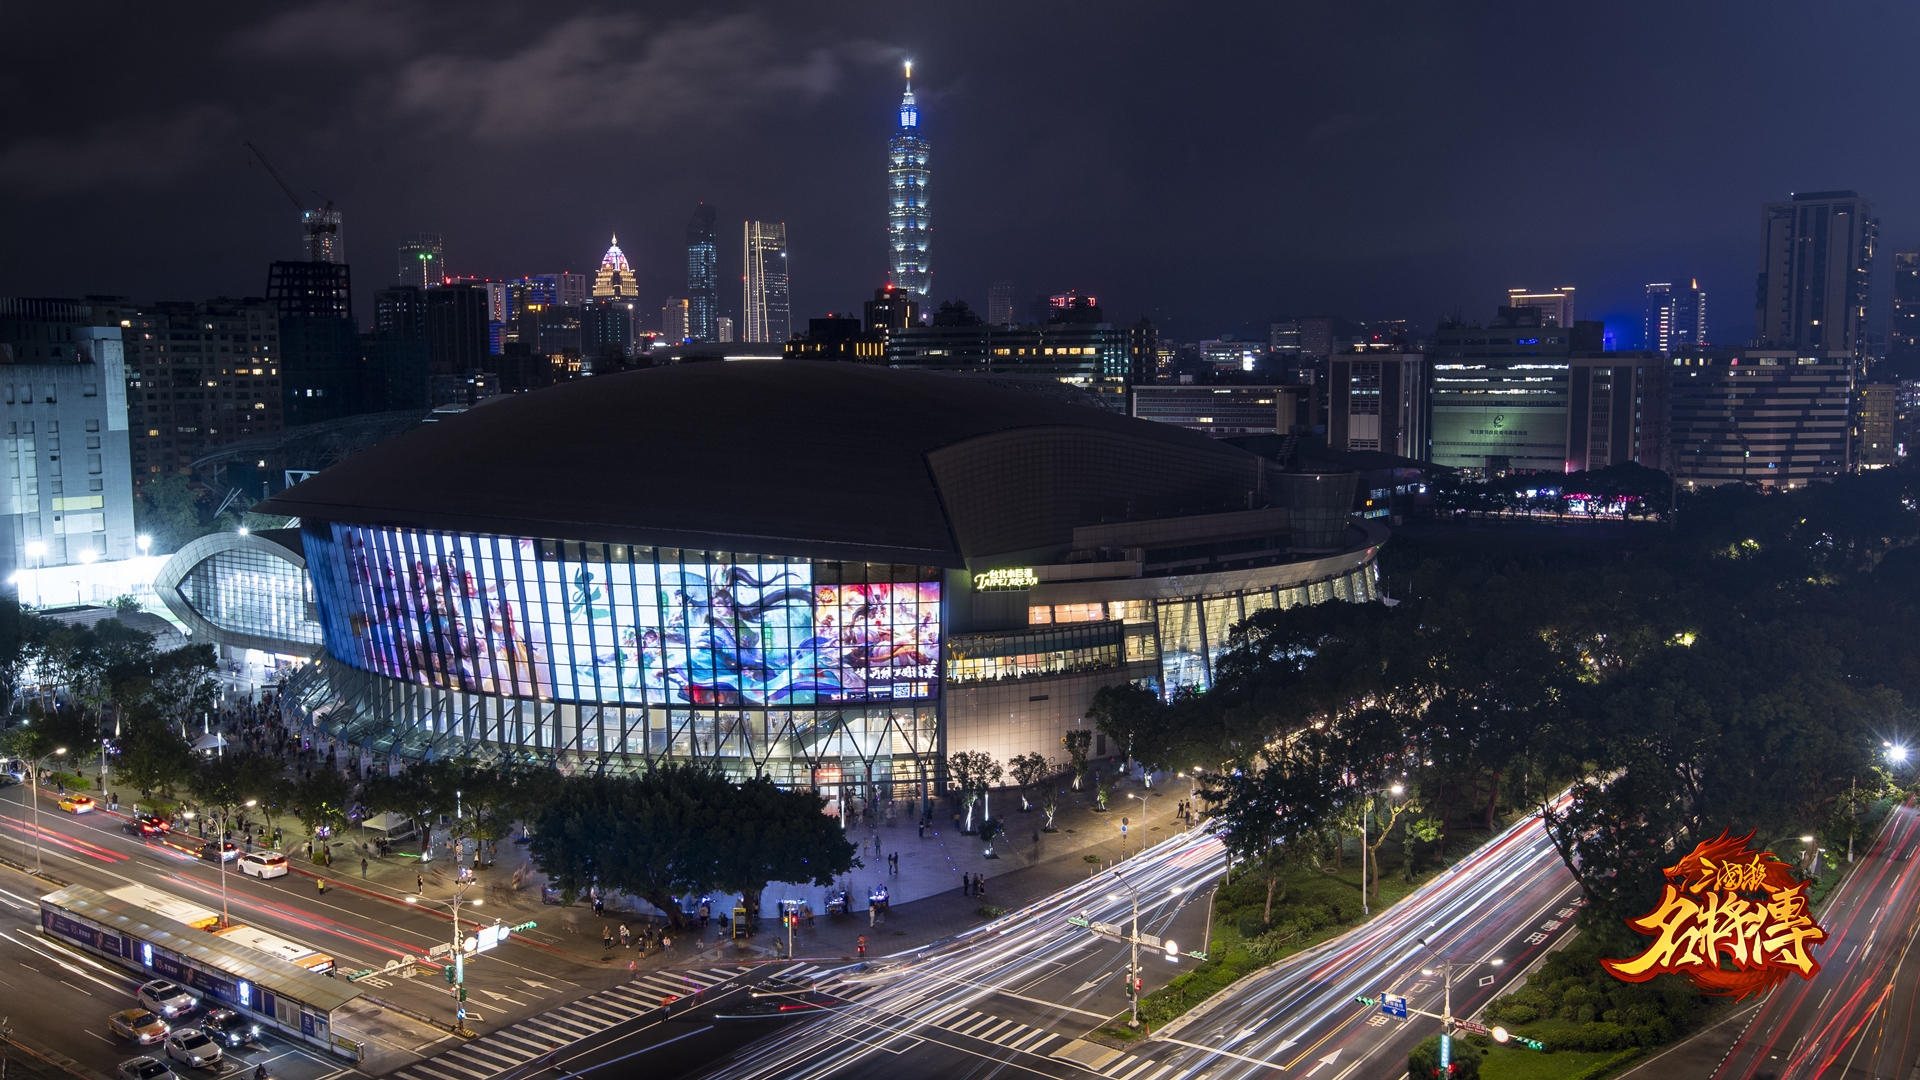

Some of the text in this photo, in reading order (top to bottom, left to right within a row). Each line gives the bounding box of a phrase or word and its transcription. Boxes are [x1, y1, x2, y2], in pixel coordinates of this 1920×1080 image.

[989, 568, 1033, 579] 台北小巨蛋
